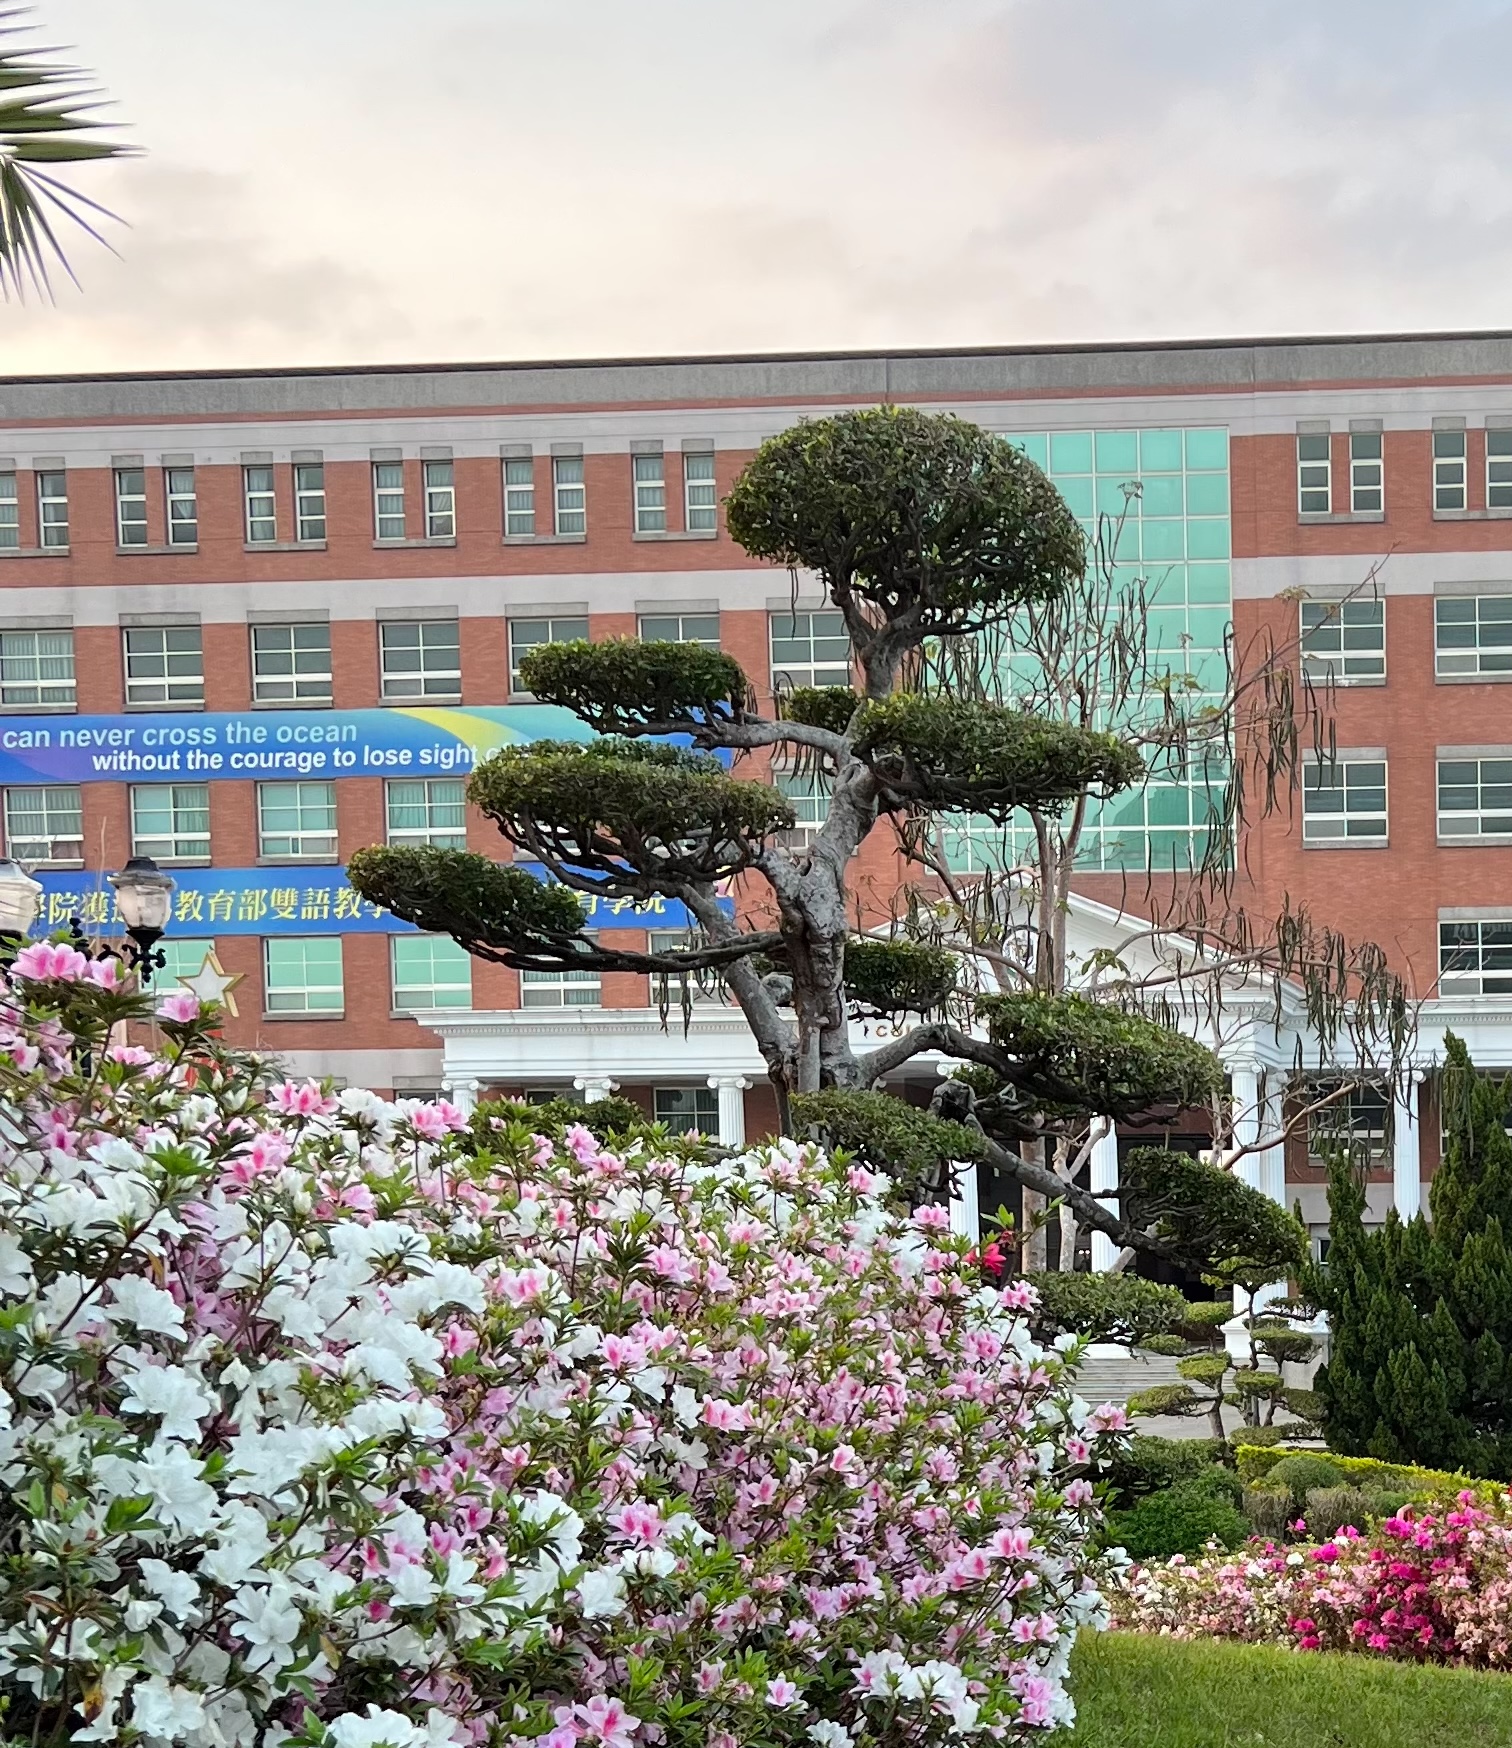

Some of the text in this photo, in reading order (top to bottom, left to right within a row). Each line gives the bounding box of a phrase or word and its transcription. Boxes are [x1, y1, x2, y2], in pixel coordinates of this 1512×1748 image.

[2, 721, 357, 749] can never cross the ocean
[91, 750, 181, 771] without
[186, 749, 224, 769] the
[230, 750, 326, 773] courage
[332, 747, 357, 767] to
[363, 745, 412, 766] lose
[418, 743, 478, 769] sight
